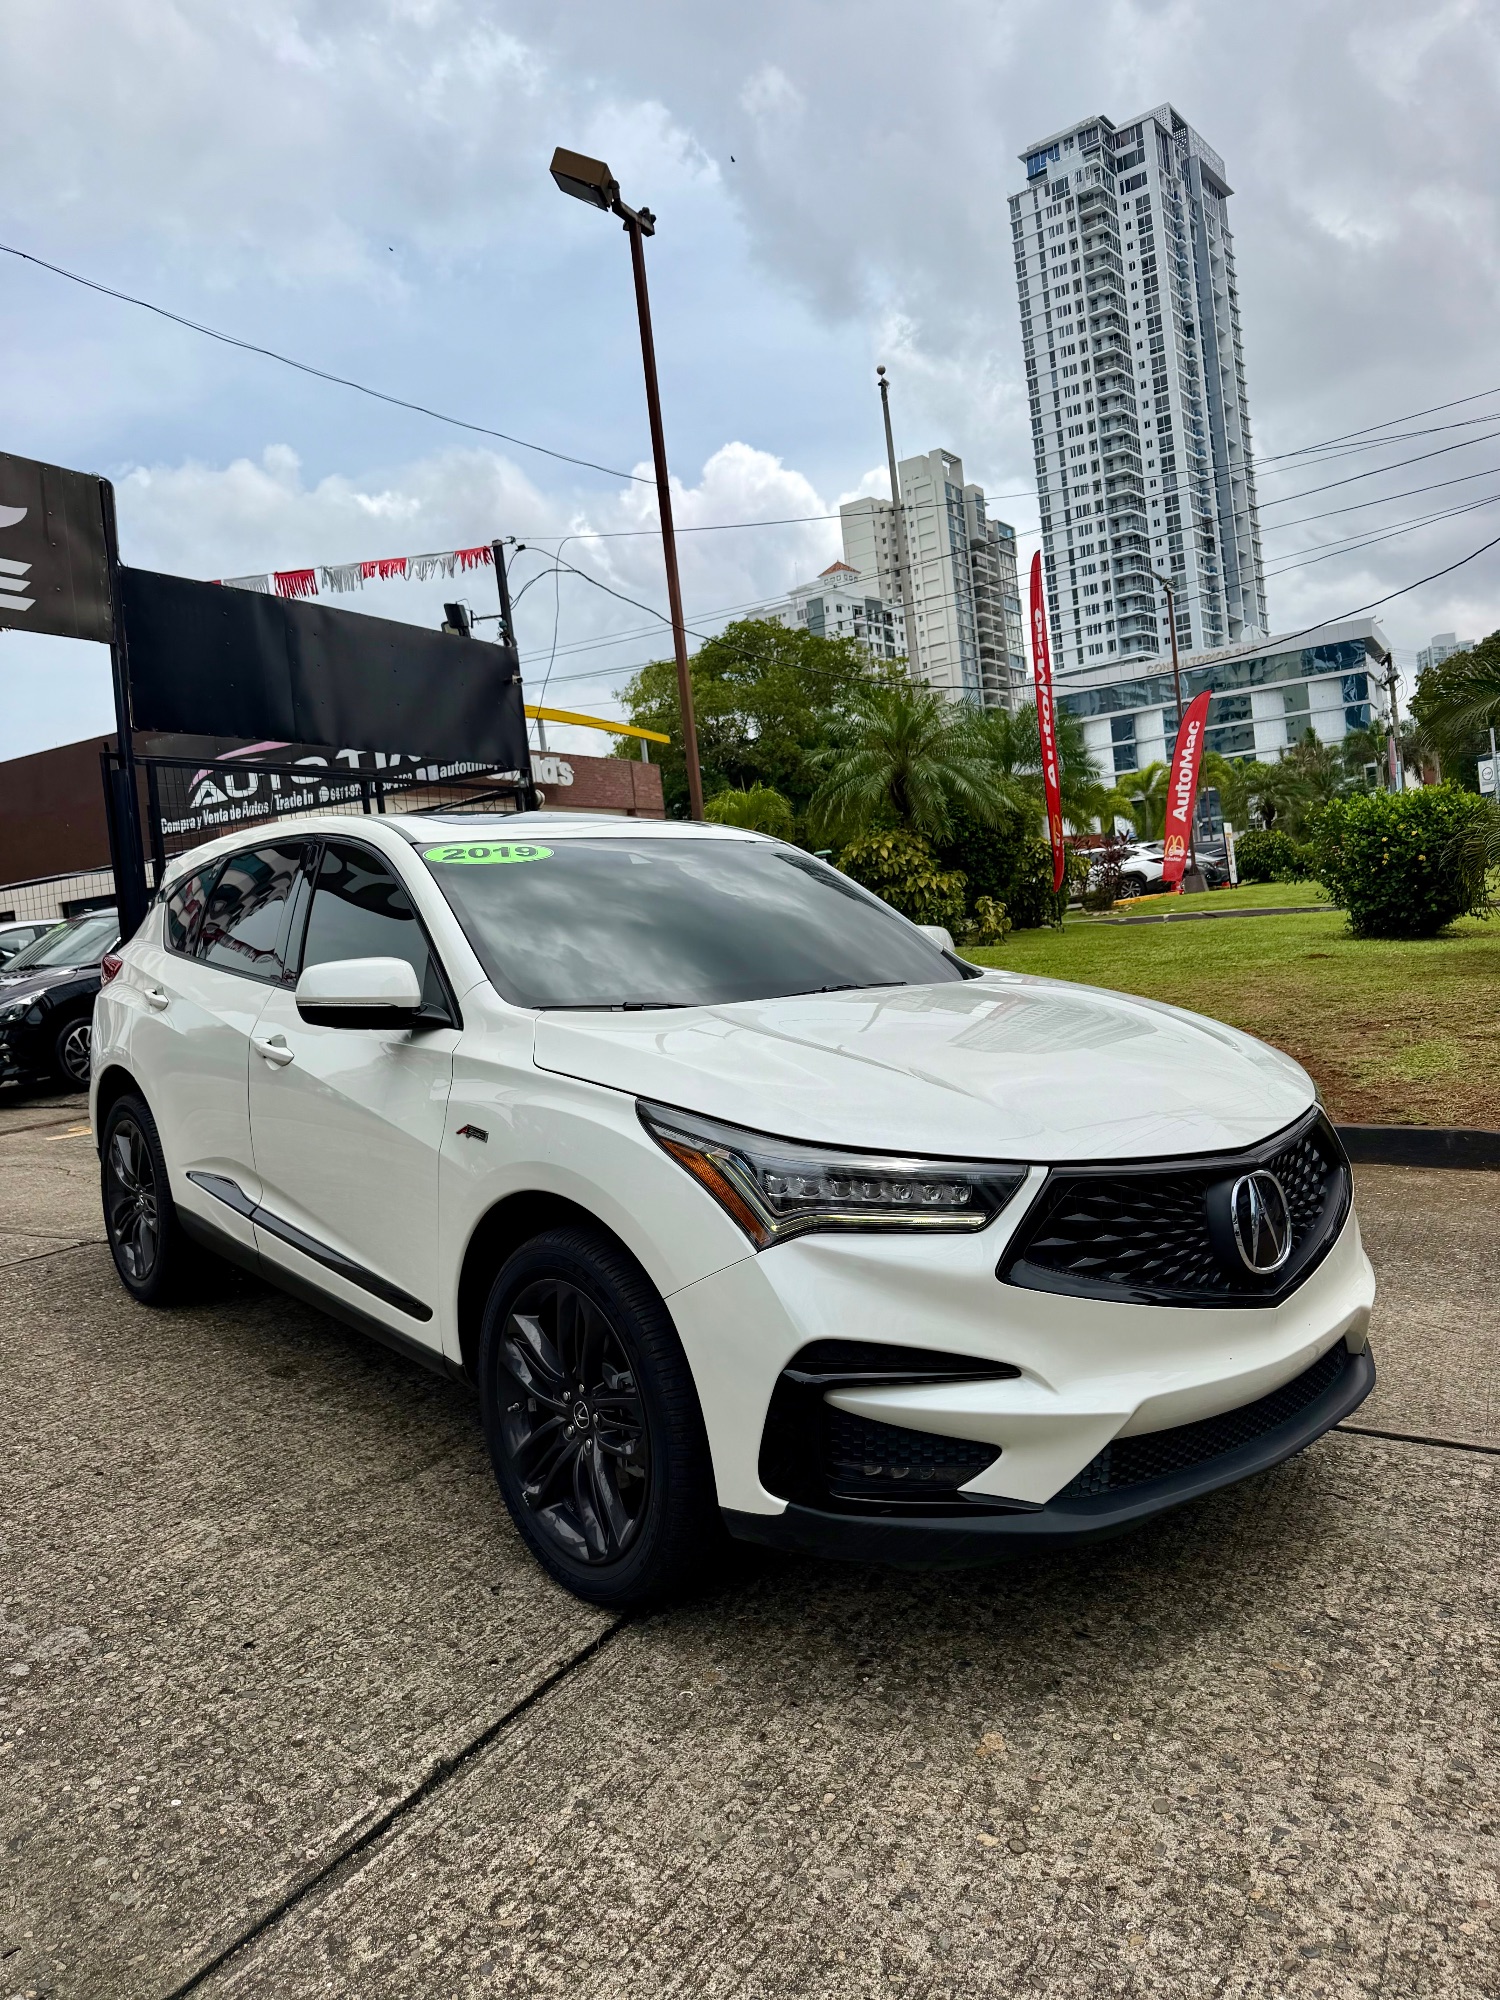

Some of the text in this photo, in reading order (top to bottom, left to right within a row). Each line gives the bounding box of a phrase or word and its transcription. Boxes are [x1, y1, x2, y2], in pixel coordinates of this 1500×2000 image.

[1172, 720, 1201, 823] AutoMac
[160, 817, 196, 835] Compra
[196, 815, 202, 831] y
[202, 808, 229, 826] Venta
[229, 804, 241, 821] de
[242, 800, 270, 818] Autos
[442, 846, 538, 860] 2019
